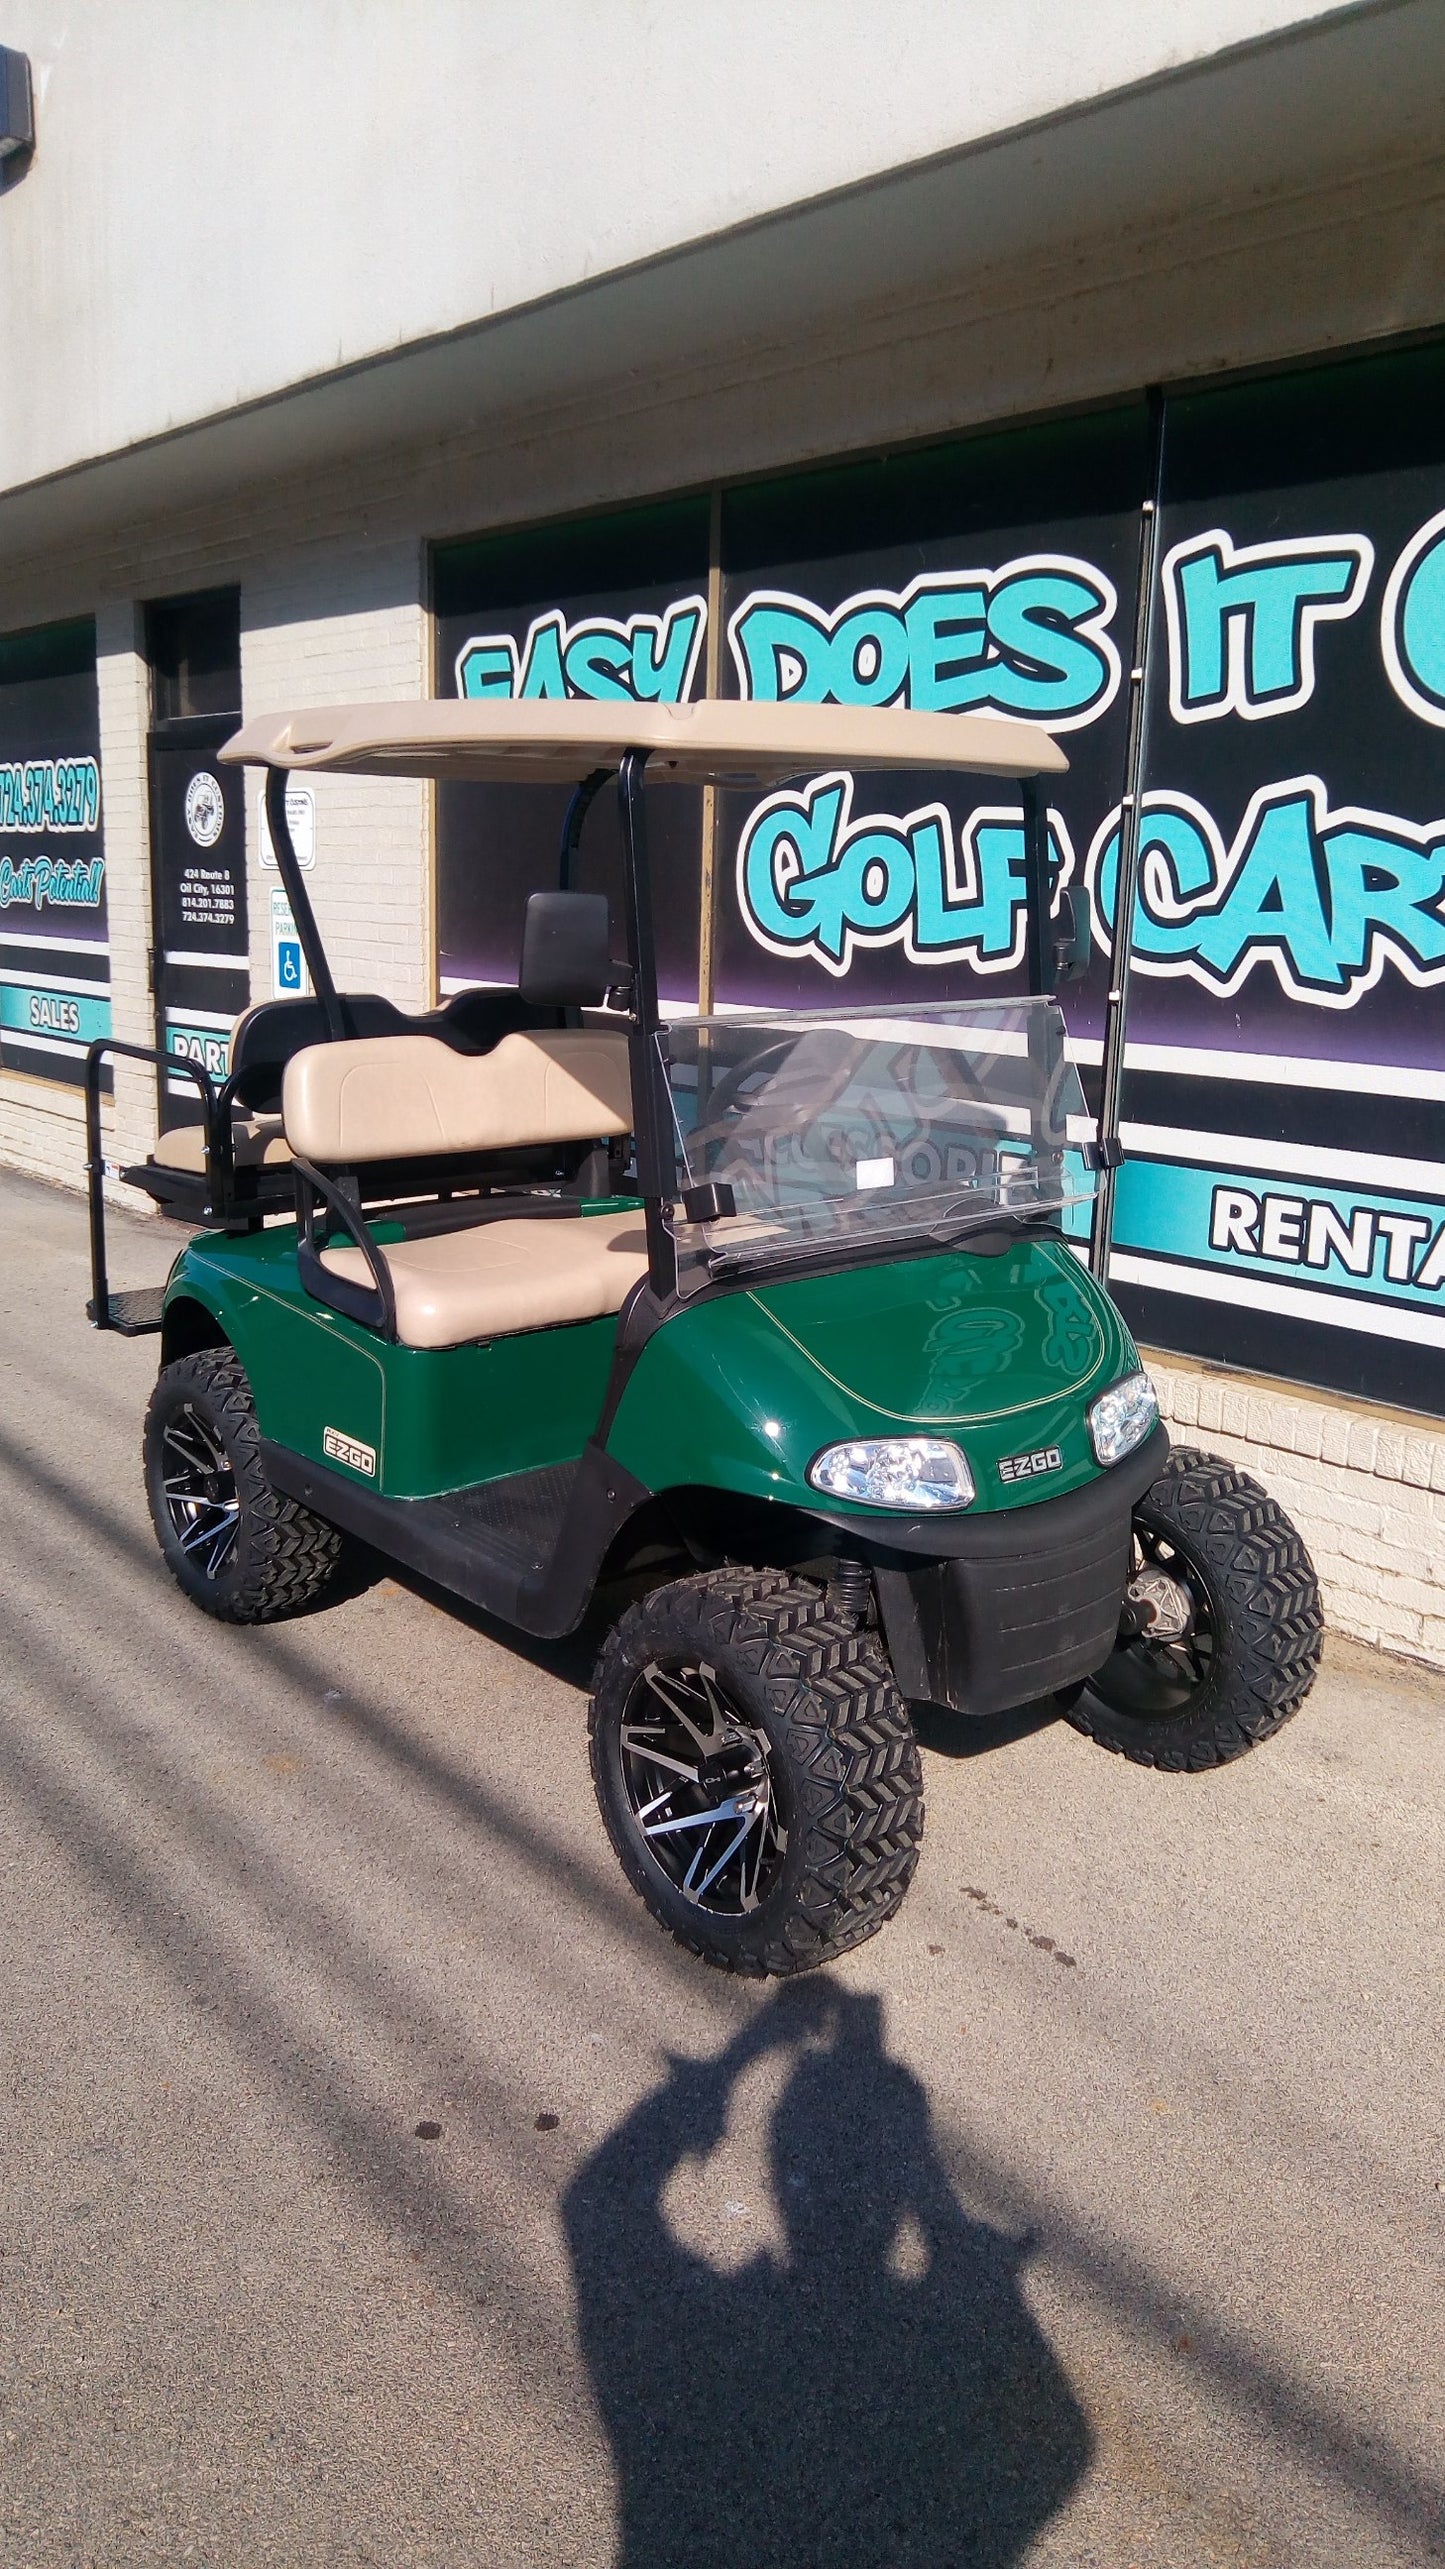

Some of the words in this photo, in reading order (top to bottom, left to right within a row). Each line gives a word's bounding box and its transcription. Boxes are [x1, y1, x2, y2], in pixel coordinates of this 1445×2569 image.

[455, 595, 707, 702] EASY
[727, 553, 1121, 733] DOES
[1162, 528, 1375, 724] IT
[180, 882, 192, 894] Oil
[193, 882, 209, 897] City,
[211, 883, 235, 896] 16301
[184, 868, 199, 880] 424
[200, 869, 223, 880] Route
[224, 869, 230, 881] 8
[737, 770, 1075, 977] GOLF
[1084, 774, 1445, 1009] CAR
[182, 897, 234, 910] 814.201.7883
[182, 910, 235, 925] 724.374.3279
[30, 996, 80, 1033] SALES
[325, 1435, 374, 1474] EZGO
[999, 1448, 1062, 1481] EZGO
